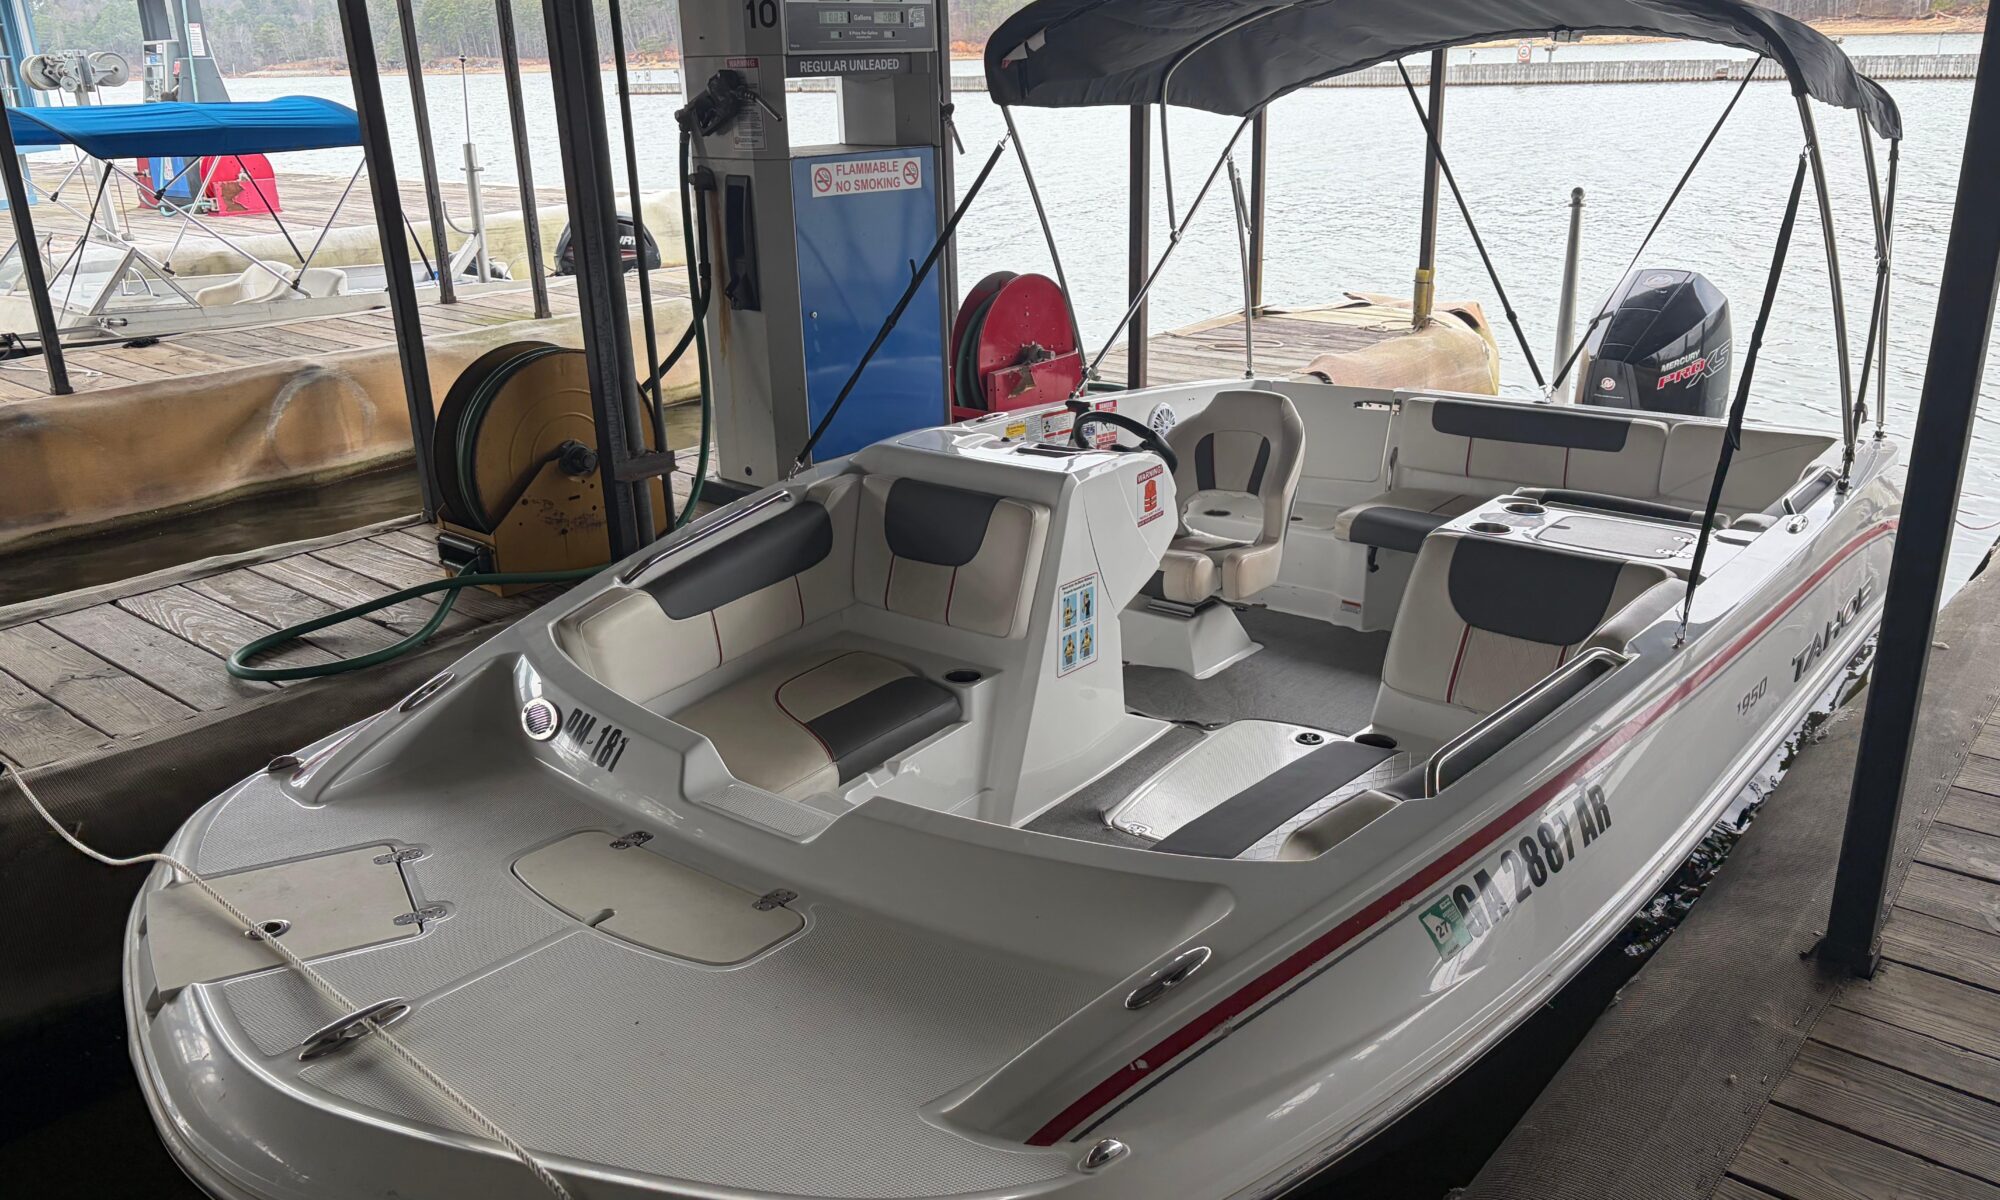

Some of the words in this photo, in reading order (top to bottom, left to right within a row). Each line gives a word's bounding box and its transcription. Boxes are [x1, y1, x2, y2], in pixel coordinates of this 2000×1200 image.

[746, 0, 778, 29] 10
[800, 60, 848, 73] REGULAR
[849, 58, 900, 71] UNLEADED
[836, 160, 899, 176] FLAMMABLE
[836, 180, 851, 192] NO
[854, 176, 901, 192] SMOKING
[1657, 357, 1706, 390] PRO
[1686, 338, 1732, 389] XS
[1661, 349, 1701, 373] MERCURY
[1791, 573, 1873, 683] TAHOE
[1737, 676, 1768, 716] 1950
[1452, 868, 1510, 938] GA
[1501, 810, 1576, 904] 2887
[1572, 784, 1612, 849] AR
[1435, 921, 1449, 939] 27
